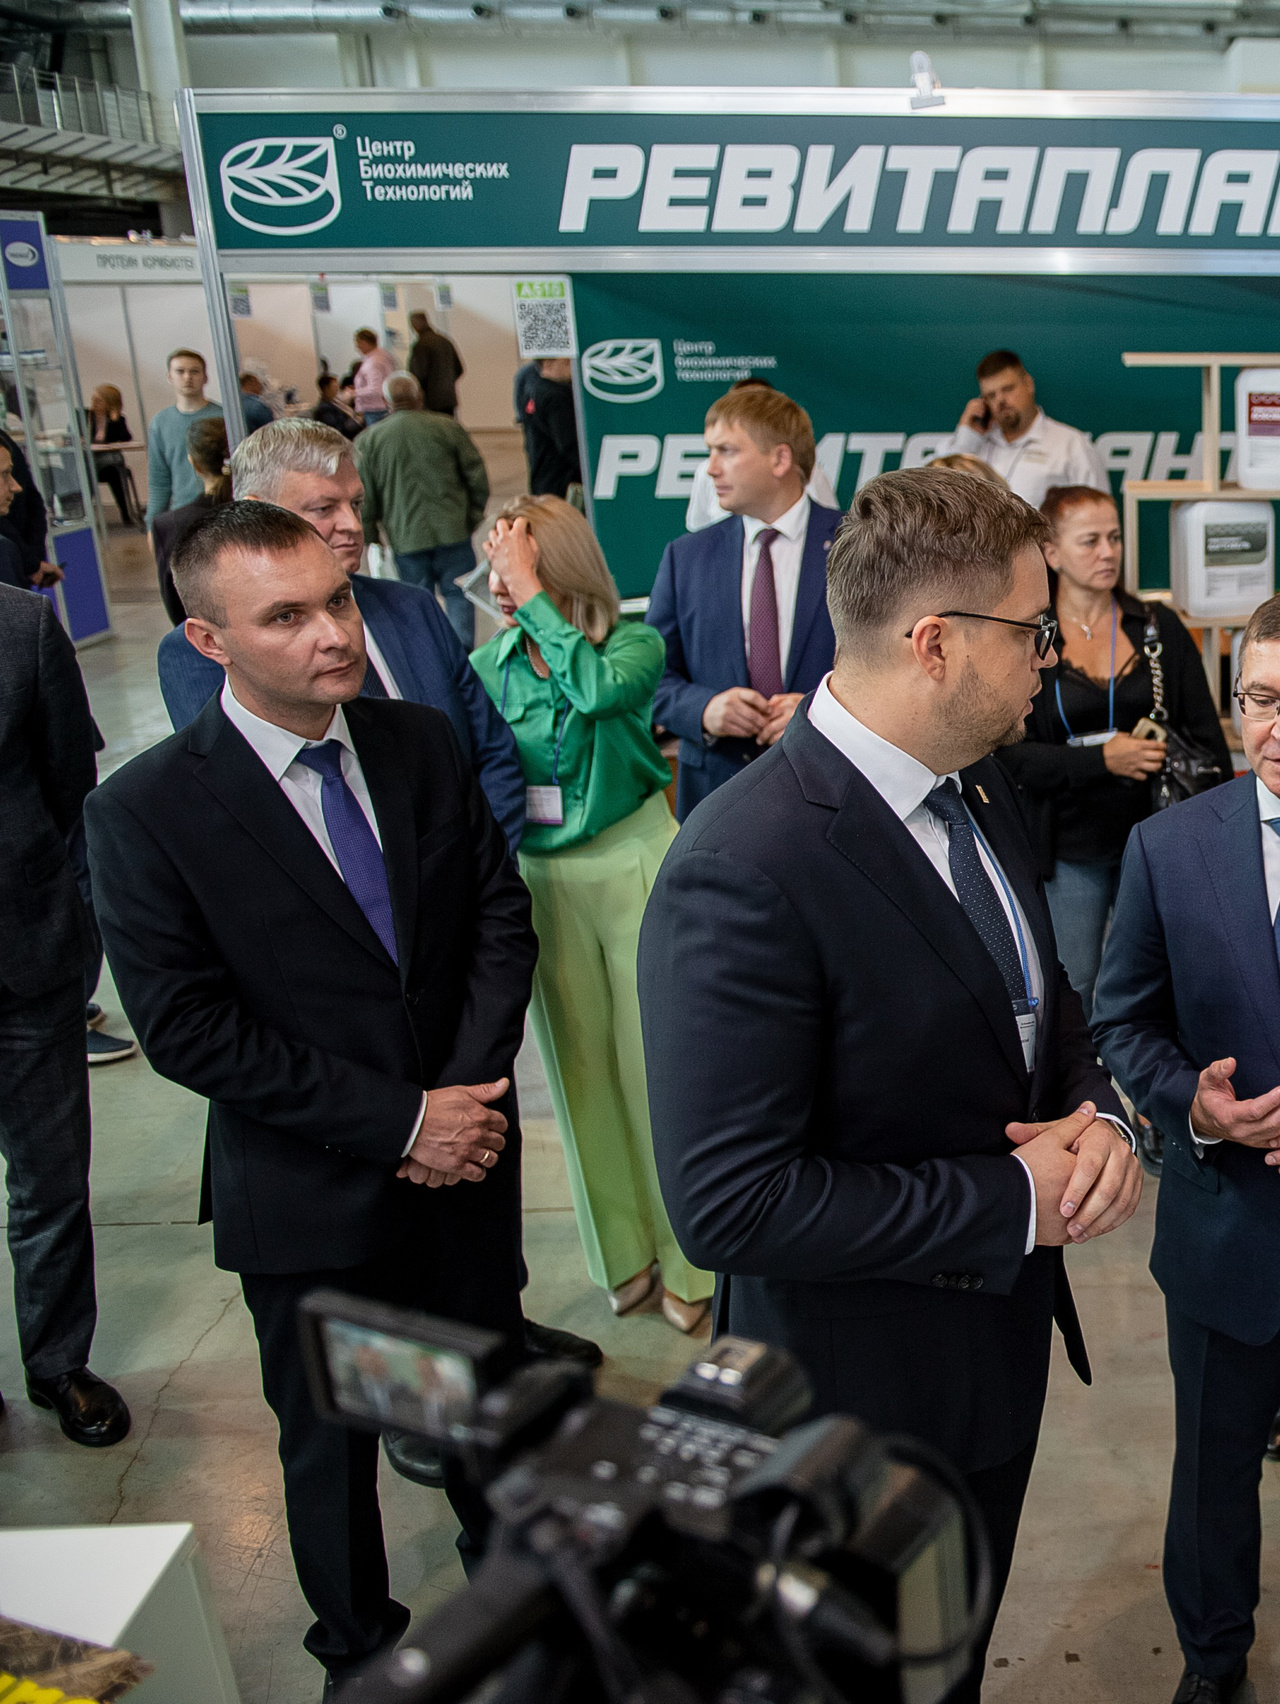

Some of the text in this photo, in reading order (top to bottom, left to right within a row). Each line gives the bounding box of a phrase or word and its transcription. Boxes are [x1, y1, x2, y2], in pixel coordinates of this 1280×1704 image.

[356, 136, 416, 161] Центр
[359, 158, 510, 179] Биохимических
[362, 180, 474, 201] Технологий
